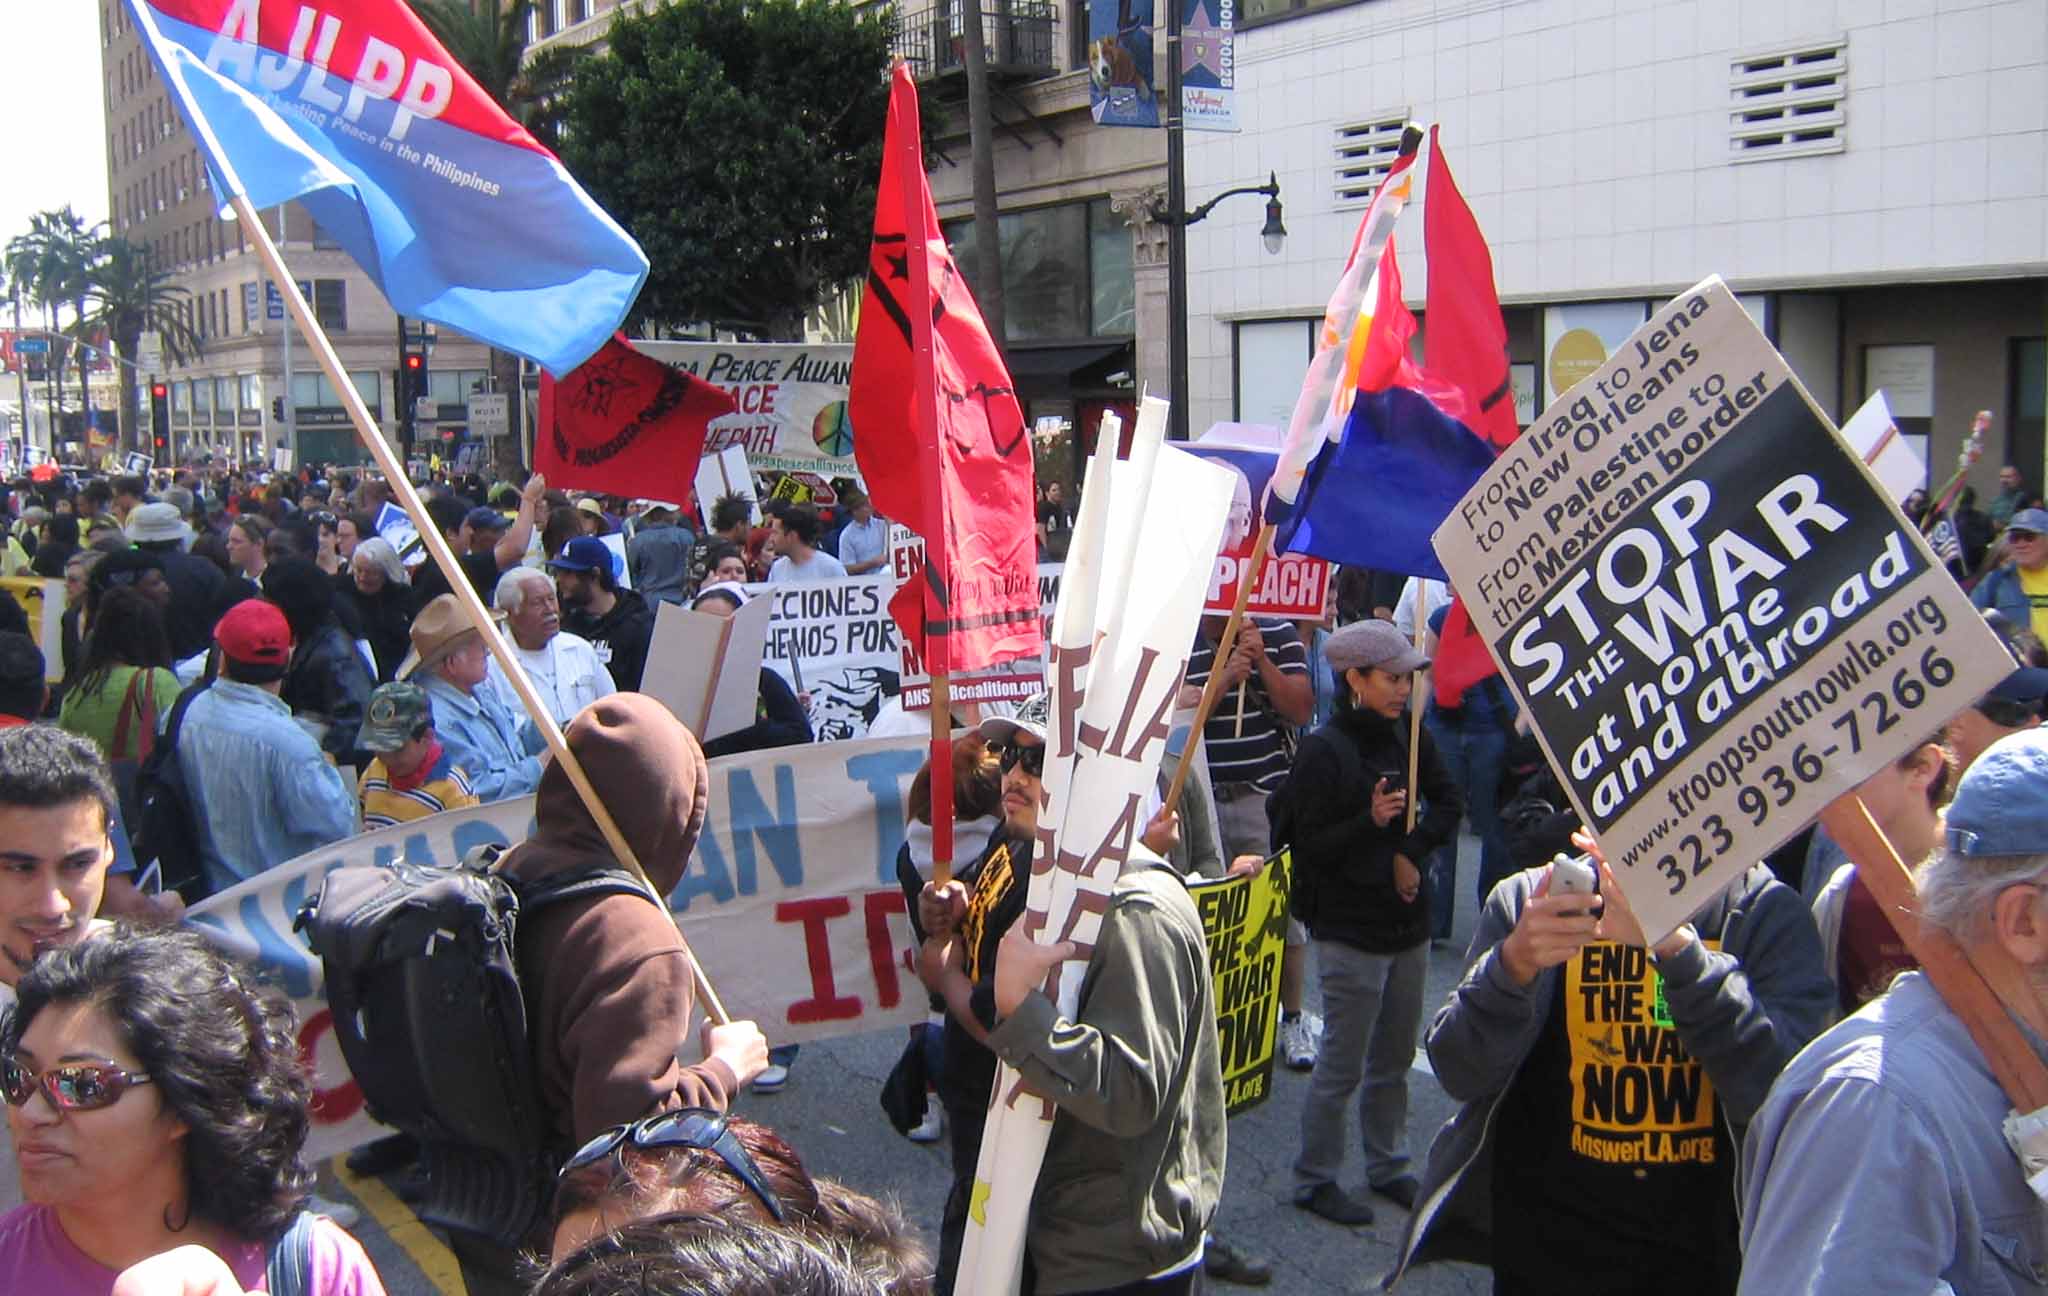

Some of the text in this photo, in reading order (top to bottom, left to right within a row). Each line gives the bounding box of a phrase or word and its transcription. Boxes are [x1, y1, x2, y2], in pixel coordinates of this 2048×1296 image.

[204, 0, 454, 141] AJLPP
[332, 117, 377, 146] Peace
[379, 137, 394, 154] in
[396, 143, 421, 165] the
[422, 151, 501, 197] Philippines
[706, 353, 781, 382] PEACE
[782, 353, 853, 385] ALLIAN
[704, 425, 778, 454] HE PATH
[1460, 294, 1710, 531] From Iraq to Jena
[1475, 341, 1701, 553] to New Orleans
[1477, 373, 1726, 604] From Palestine to
[1491, 370, 1768, 629] the Mexican border
[894, 544, 924, 579] EN
[1207, 556, 1321, 606] PEACH
[1508, 478, 1711, 697] STOP
[1554, 473, 1849, 710] THE WAR
[762, 619, 898, 660] HEMOS POR
[1591, 531, 1910, 819] and abroad
[1570, 587, 1785, 781] at home
[1621, 595, 1948, 868] www.troopsoutnowla.org
[1656, 645, 1956, 895] 323 936-7266
[1201, 883, 1251, 933] END
[1221, 952, 1275, 1013] WAR
[1579, 984, 1644, 1023] THE
[1580, 945, 1647, 983] END
[1582, 1063, 1702, 1125] NOW
[1571, 1122, 1715, 1164] AnswerLA.org
